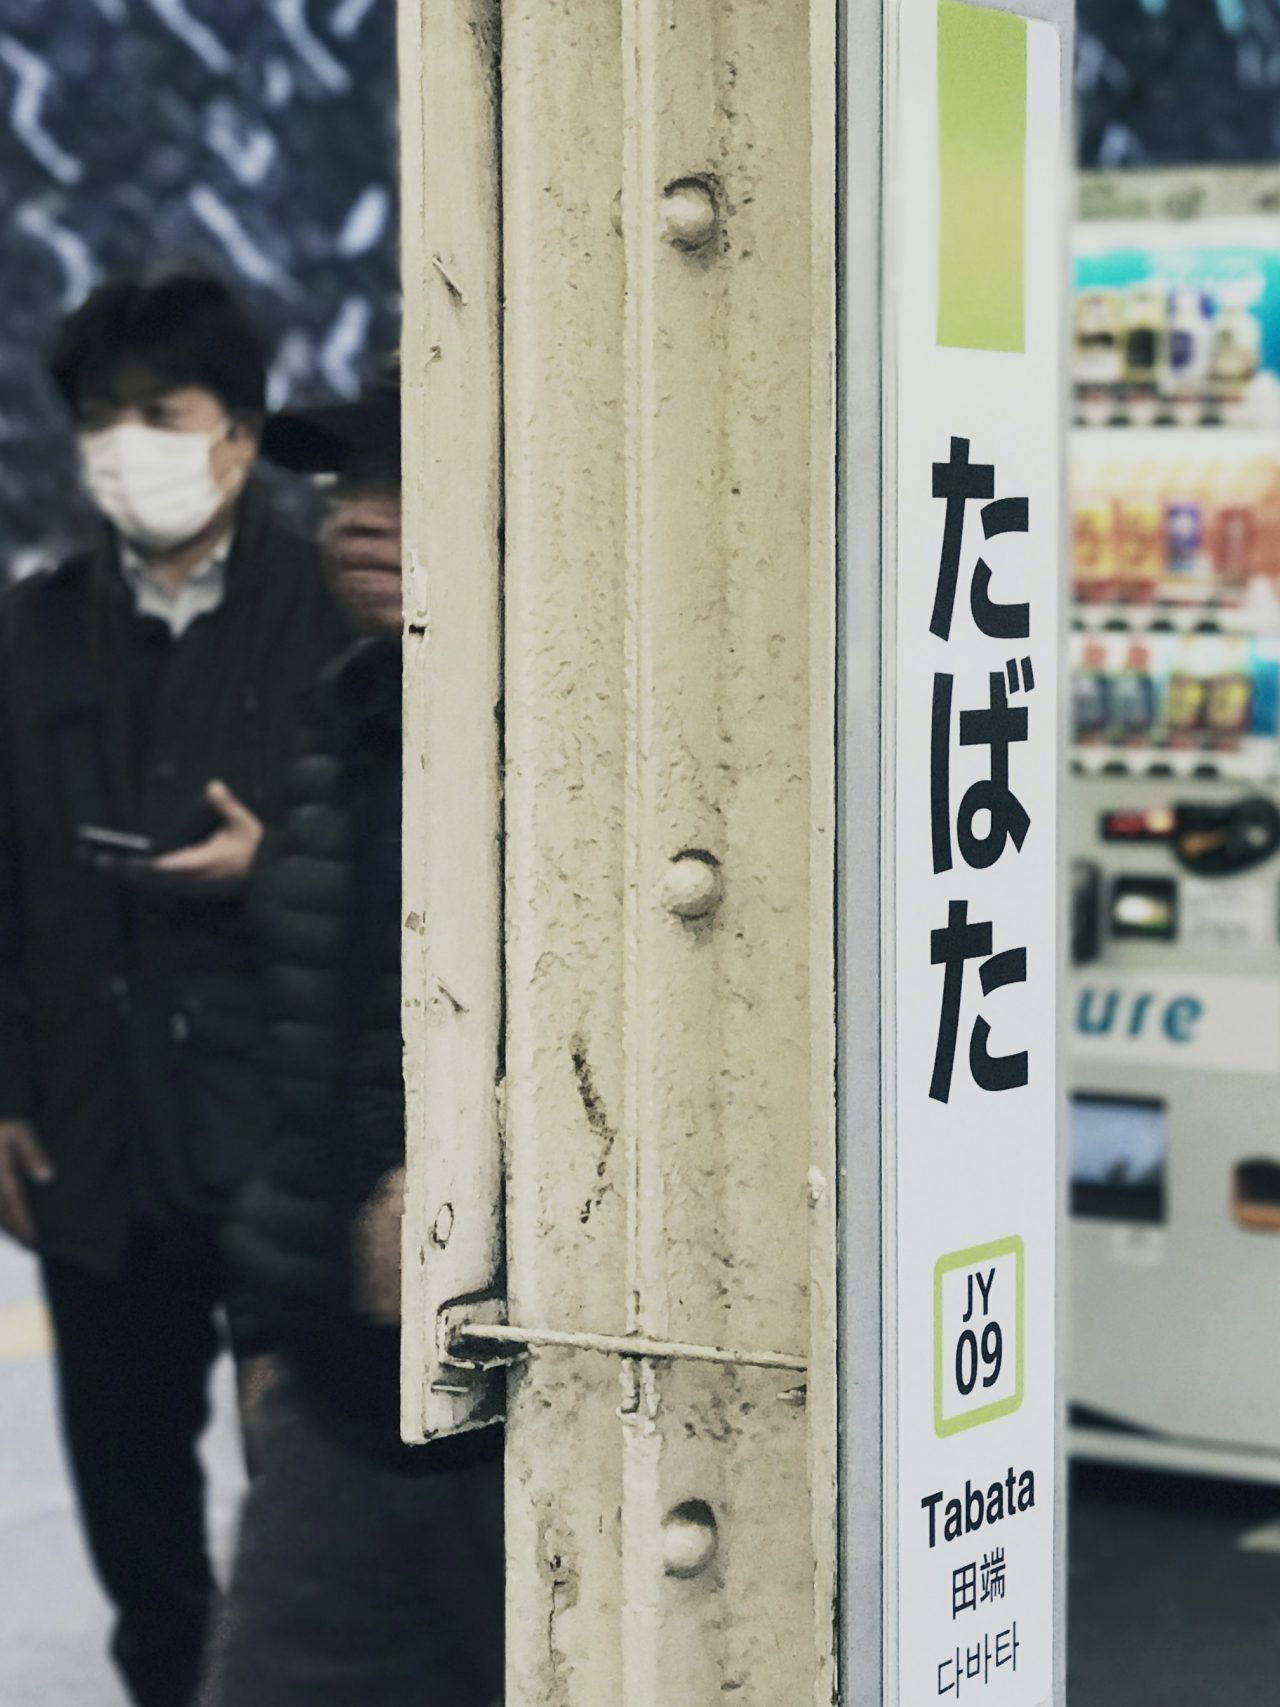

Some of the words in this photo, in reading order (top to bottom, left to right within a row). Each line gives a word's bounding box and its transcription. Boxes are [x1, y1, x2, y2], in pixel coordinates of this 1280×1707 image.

[928, 435, 1035, 1104] たばた
[962, 1267, 997, 1324] JY
[955, 1321, 1003, 1396] 09
[921, 1466, 1036, 1549] Tabata
[952, 1545, 1006, 1620] 田端
[937, 1620, 1020, 1699] 다바타
